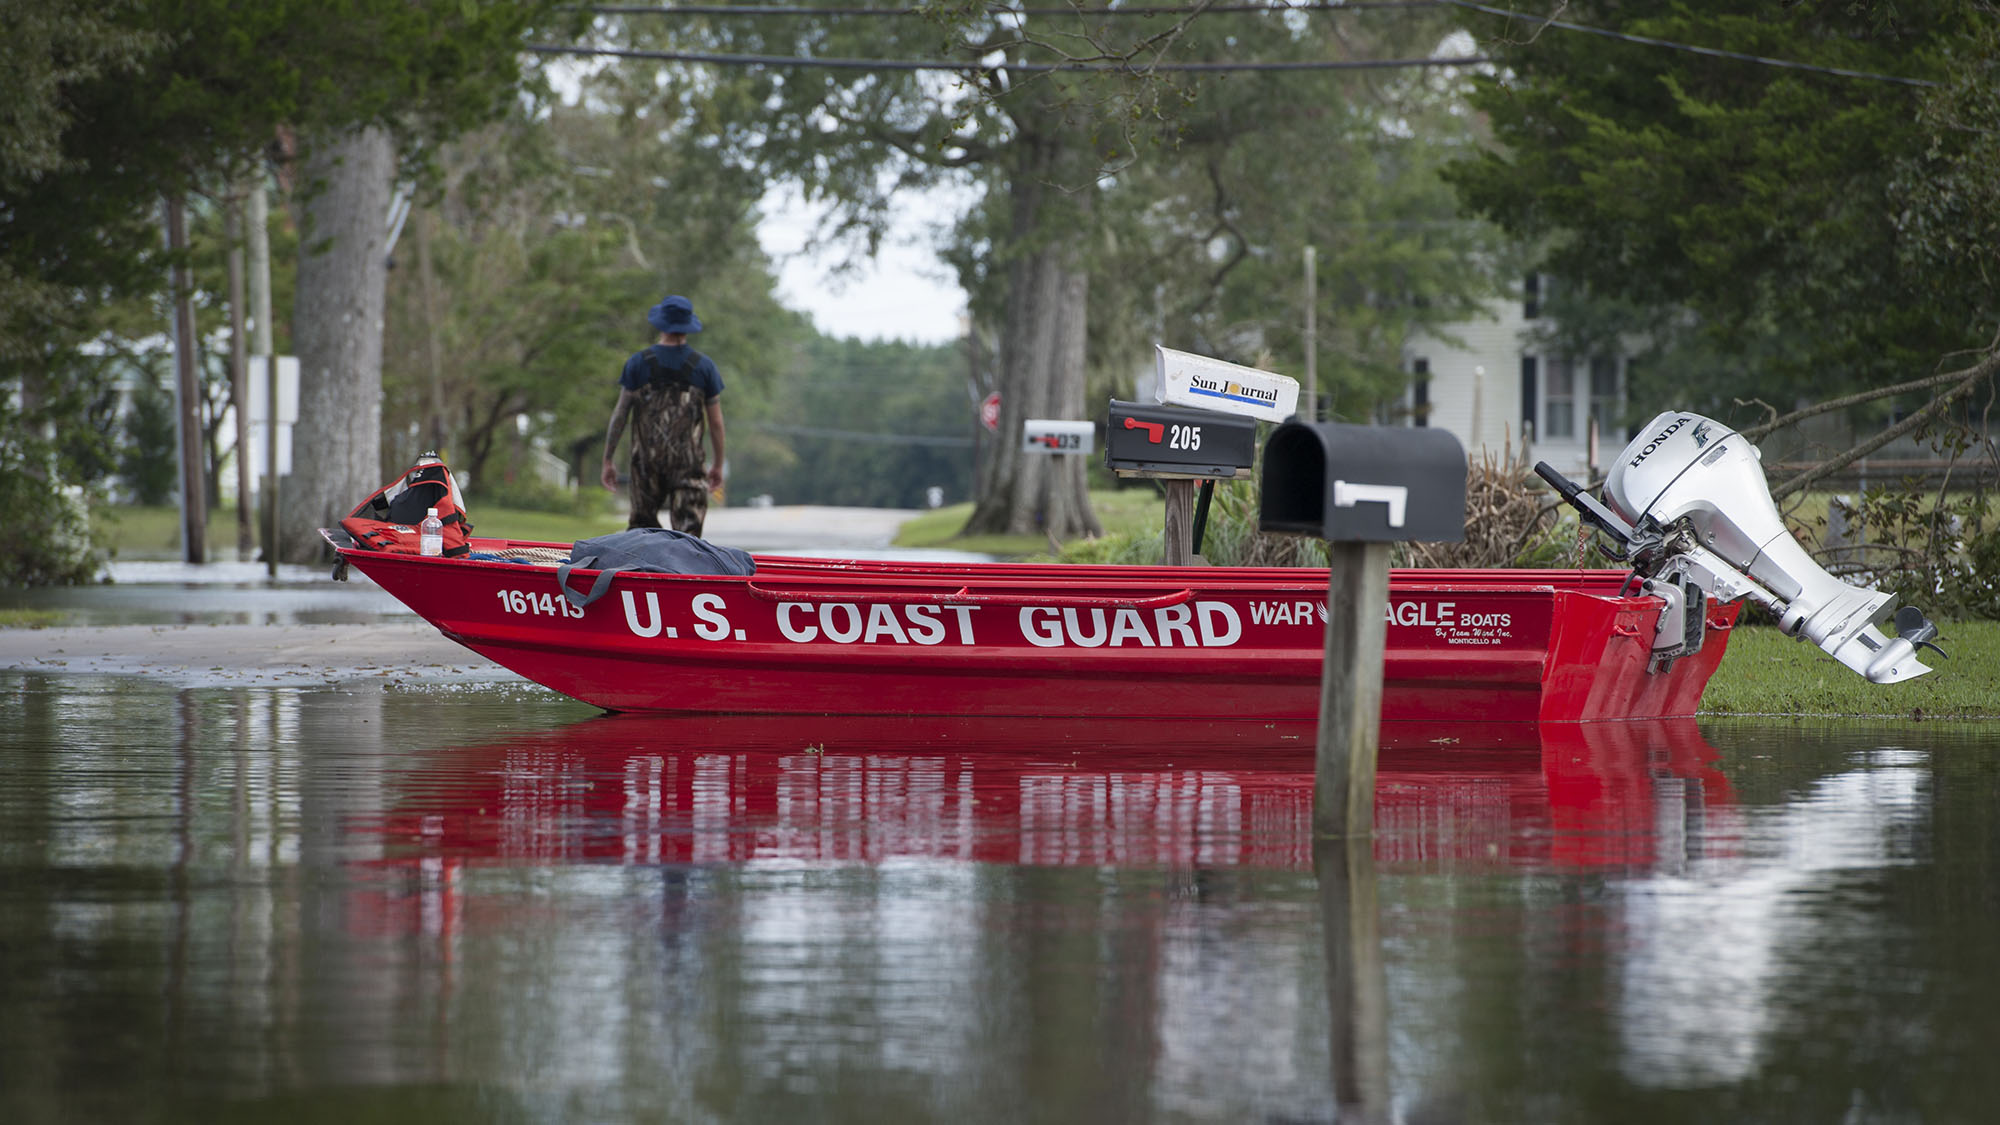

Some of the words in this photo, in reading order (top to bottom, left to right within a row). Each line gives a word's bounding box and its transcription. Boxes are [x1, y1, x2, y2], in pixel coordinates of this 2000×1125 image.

[1191, 375, 1217, 391] Sun
[1170, 425, 1201, 451] 205
[1628, 418, 1692, 469] HONDA
[621, 590, 679, 638] U.
[691, 593, 747, 641] S.
[776, 602, 982, 645] COAST
[1019, 601, 1242, 647] GUARD
[1249, 601, 1315, 625] WAR
[1384, 601, 1456, 626] AGLE
[1460, 613, 1512, 627] BOATS
[1435, 628, 1447, 638] By
[1449, 628, 1471, 637] Team
[1496, 628, 1512, 638] Inc.
